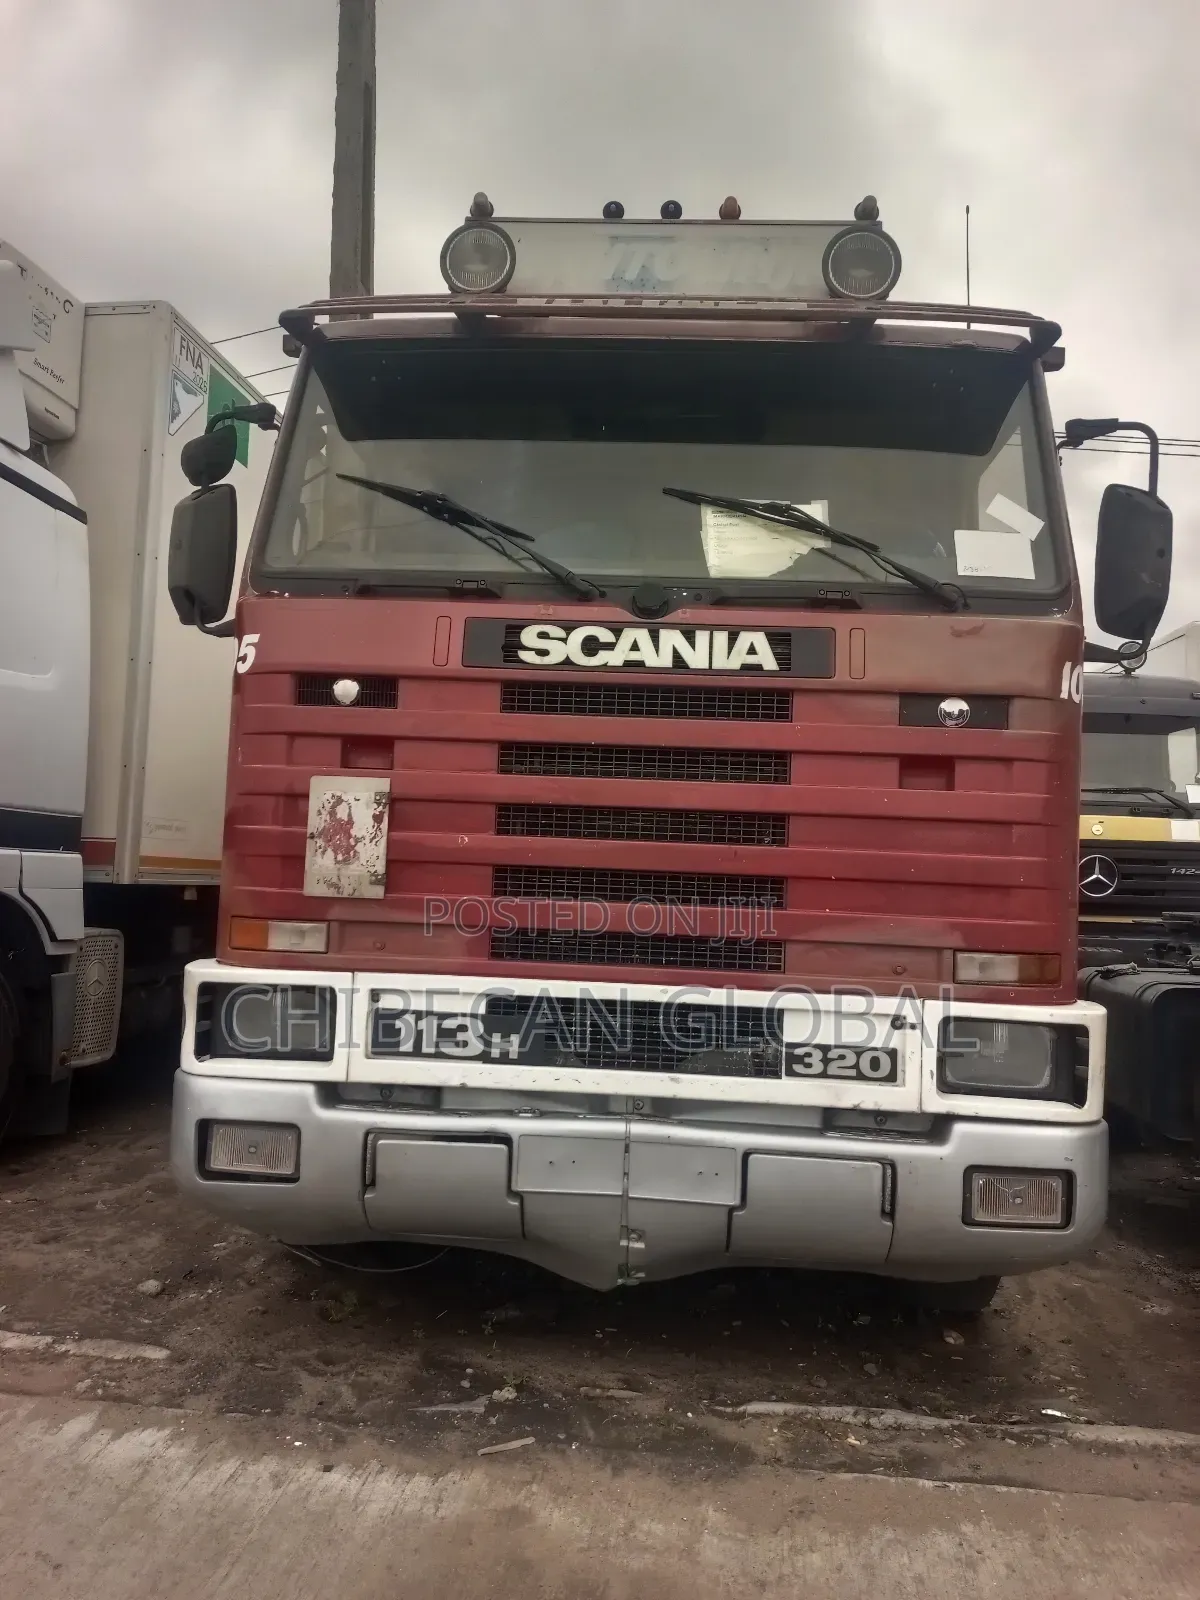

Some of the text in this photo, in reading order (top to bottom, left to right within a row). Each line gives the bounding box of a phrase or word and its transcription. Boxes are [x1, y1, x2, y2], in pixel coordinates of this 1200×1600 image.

[179, 334, 204, 375] FNA
[517, 624, 780, 671] SCANIA
[791, 1047, 892, 1079] 320
